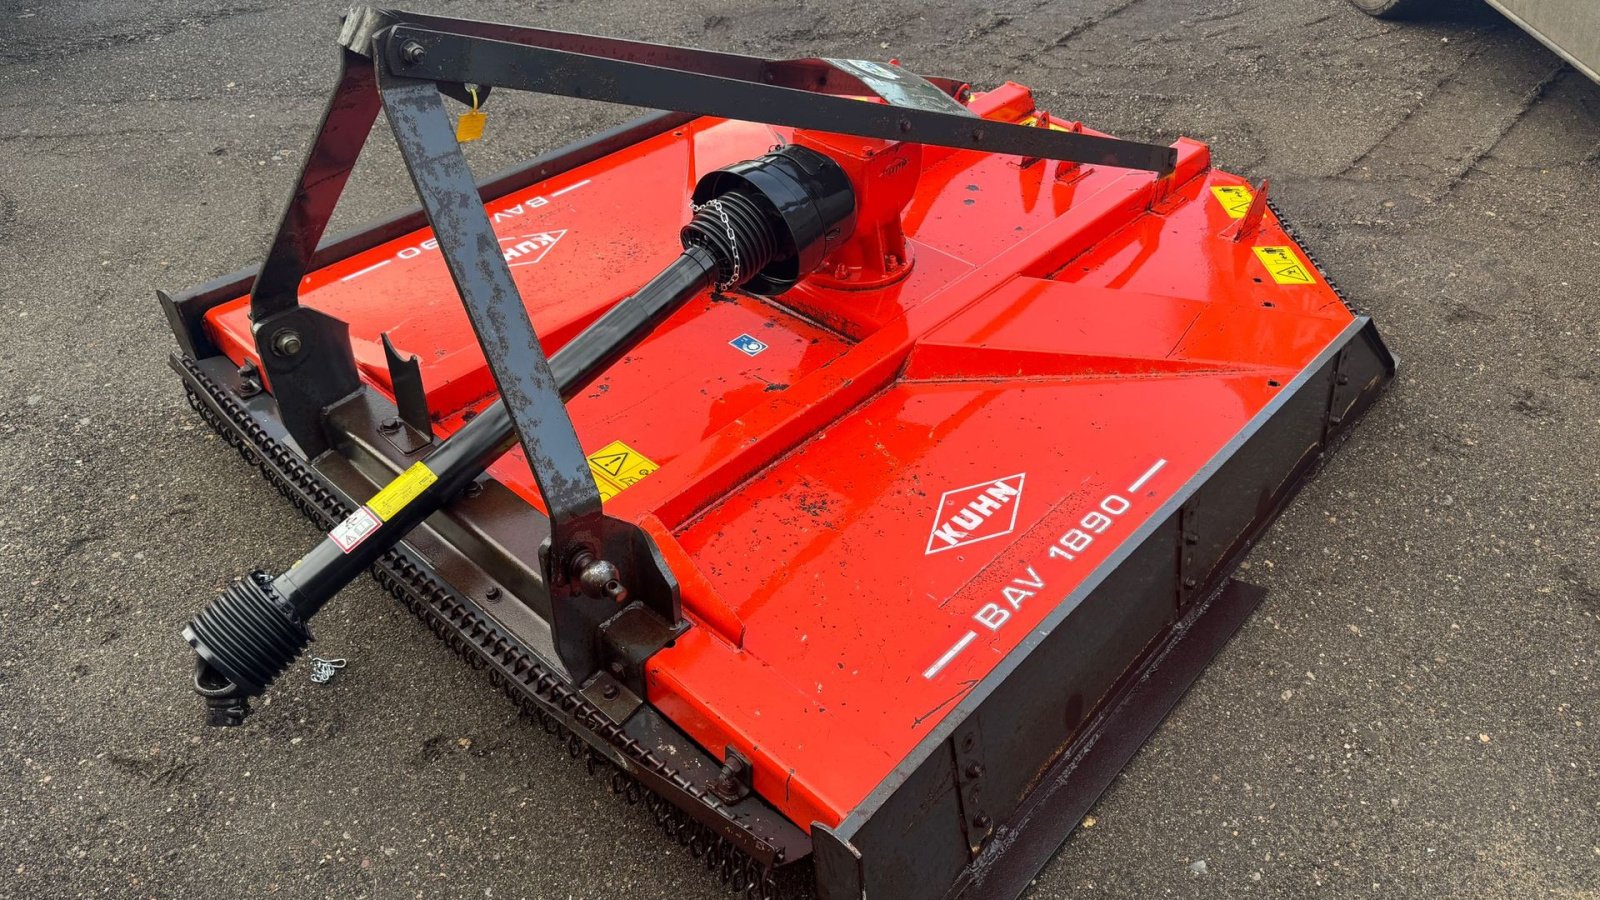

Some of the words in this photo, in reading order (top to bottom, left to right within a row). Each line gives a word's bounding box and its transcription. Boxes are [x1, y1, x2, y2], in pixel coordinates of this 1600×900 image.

[493, 196, 549, 223] BAV
[504, 233, 556, 262] KUH
[933, 480, 1019, 546] KUHN
[973, 566, 1046, 631] BAV
[1048, 494, 1131, 560] 1890
